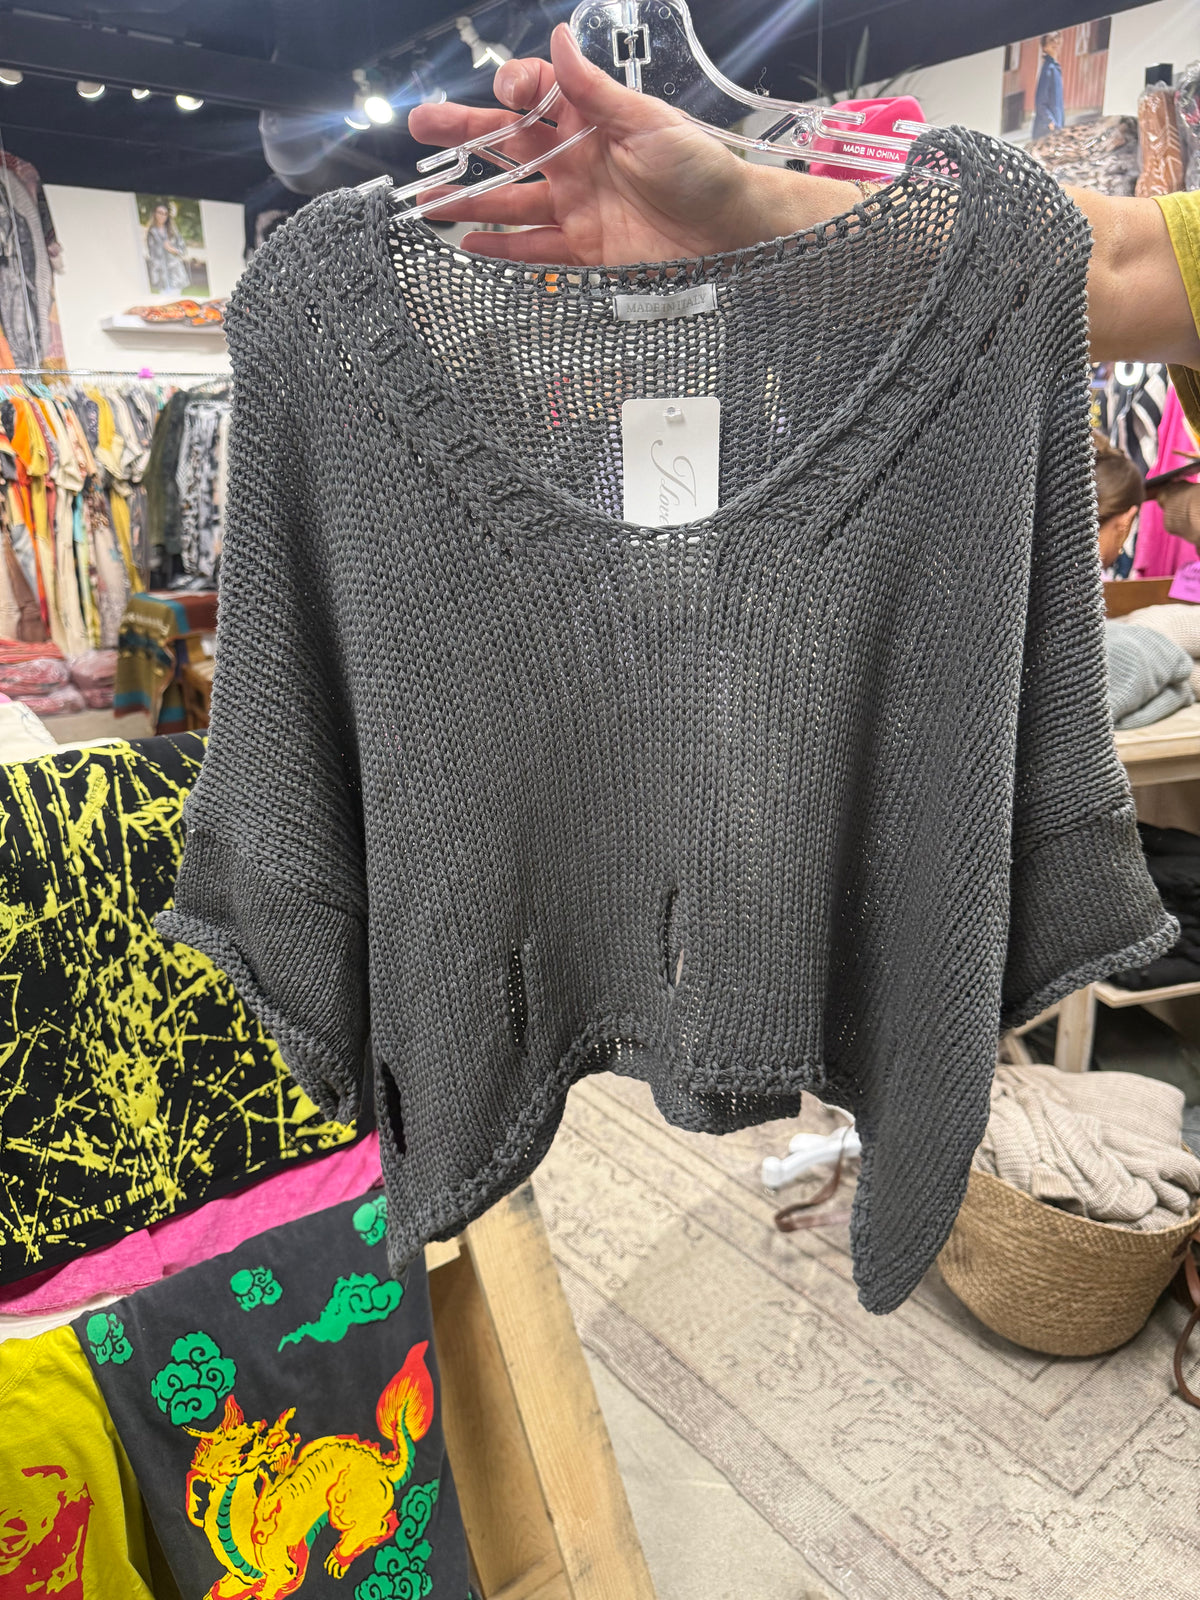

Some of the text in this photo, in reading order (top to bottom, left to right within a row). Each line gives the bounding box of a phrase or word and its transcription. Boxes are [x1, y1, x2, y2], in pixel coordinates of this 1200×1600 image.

[843, 144, 900, 161] MADE IN CHINA
[626, 293, 706, 313] MADE IN ITALY
[38, 1221, 47, 1236] A
[52, 1204, 100, 1231] STATE
[104, 1195, 122, 1214] OF
